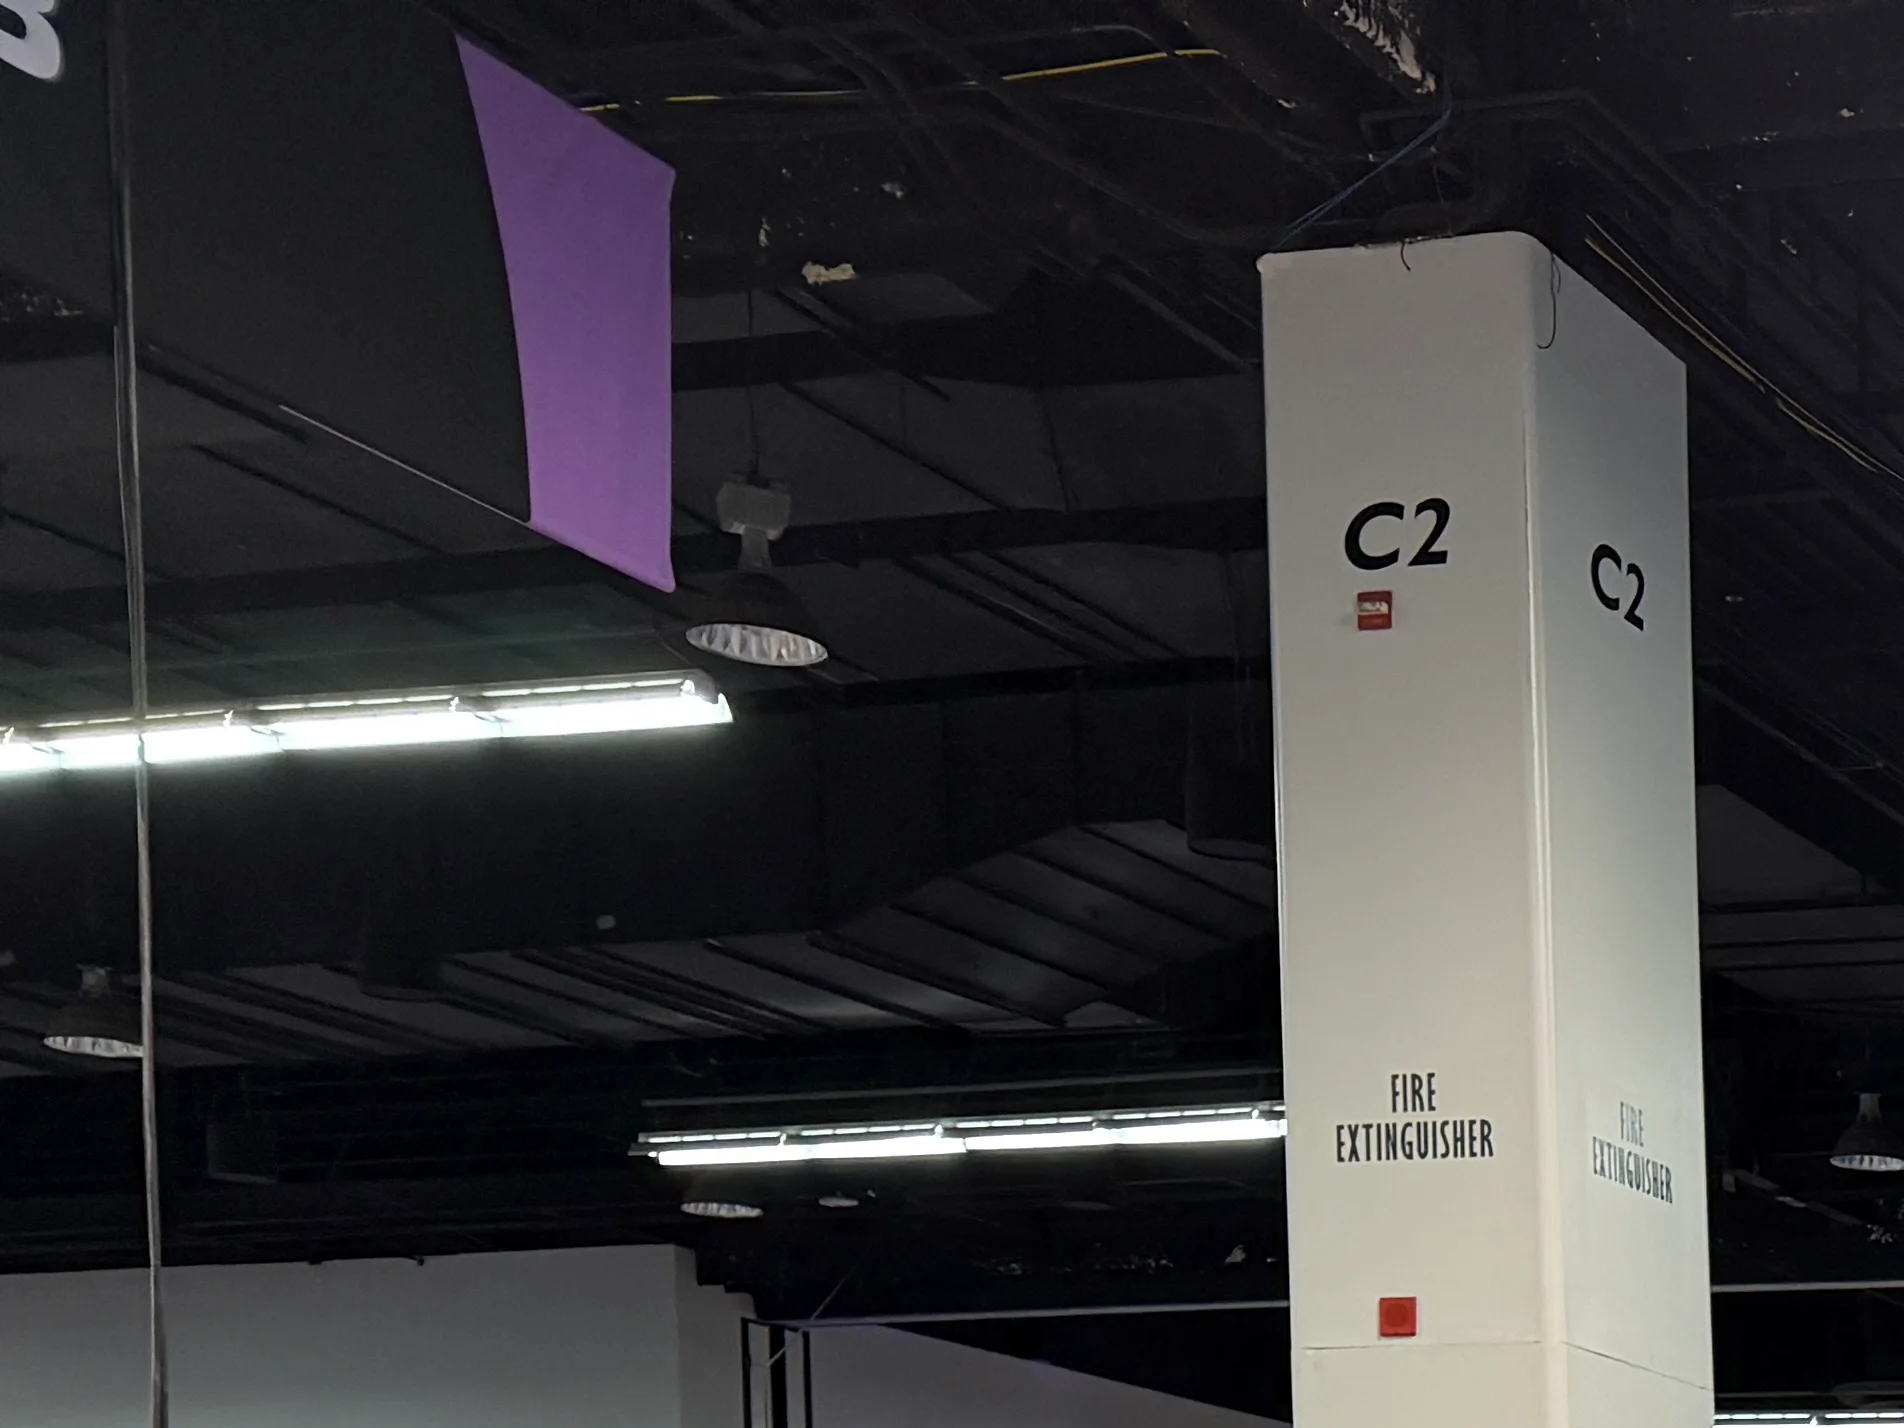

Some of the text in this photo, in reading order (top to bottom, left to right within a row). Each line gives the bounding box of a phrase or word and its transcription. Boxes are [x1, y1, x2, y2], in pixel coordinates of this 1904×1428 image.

[1344, 498, 1451, 570] C2
[1590, 543, 1645, 631] C2
[1390, 1072, 1437, 1113] FIRE
[1336, 1119, 1494, 1163] EXTINGUISHER
[1619, 1101, 1644, 1148] FIRE
[1592, 1136, 1673, 1205] EXTINGUISHER
